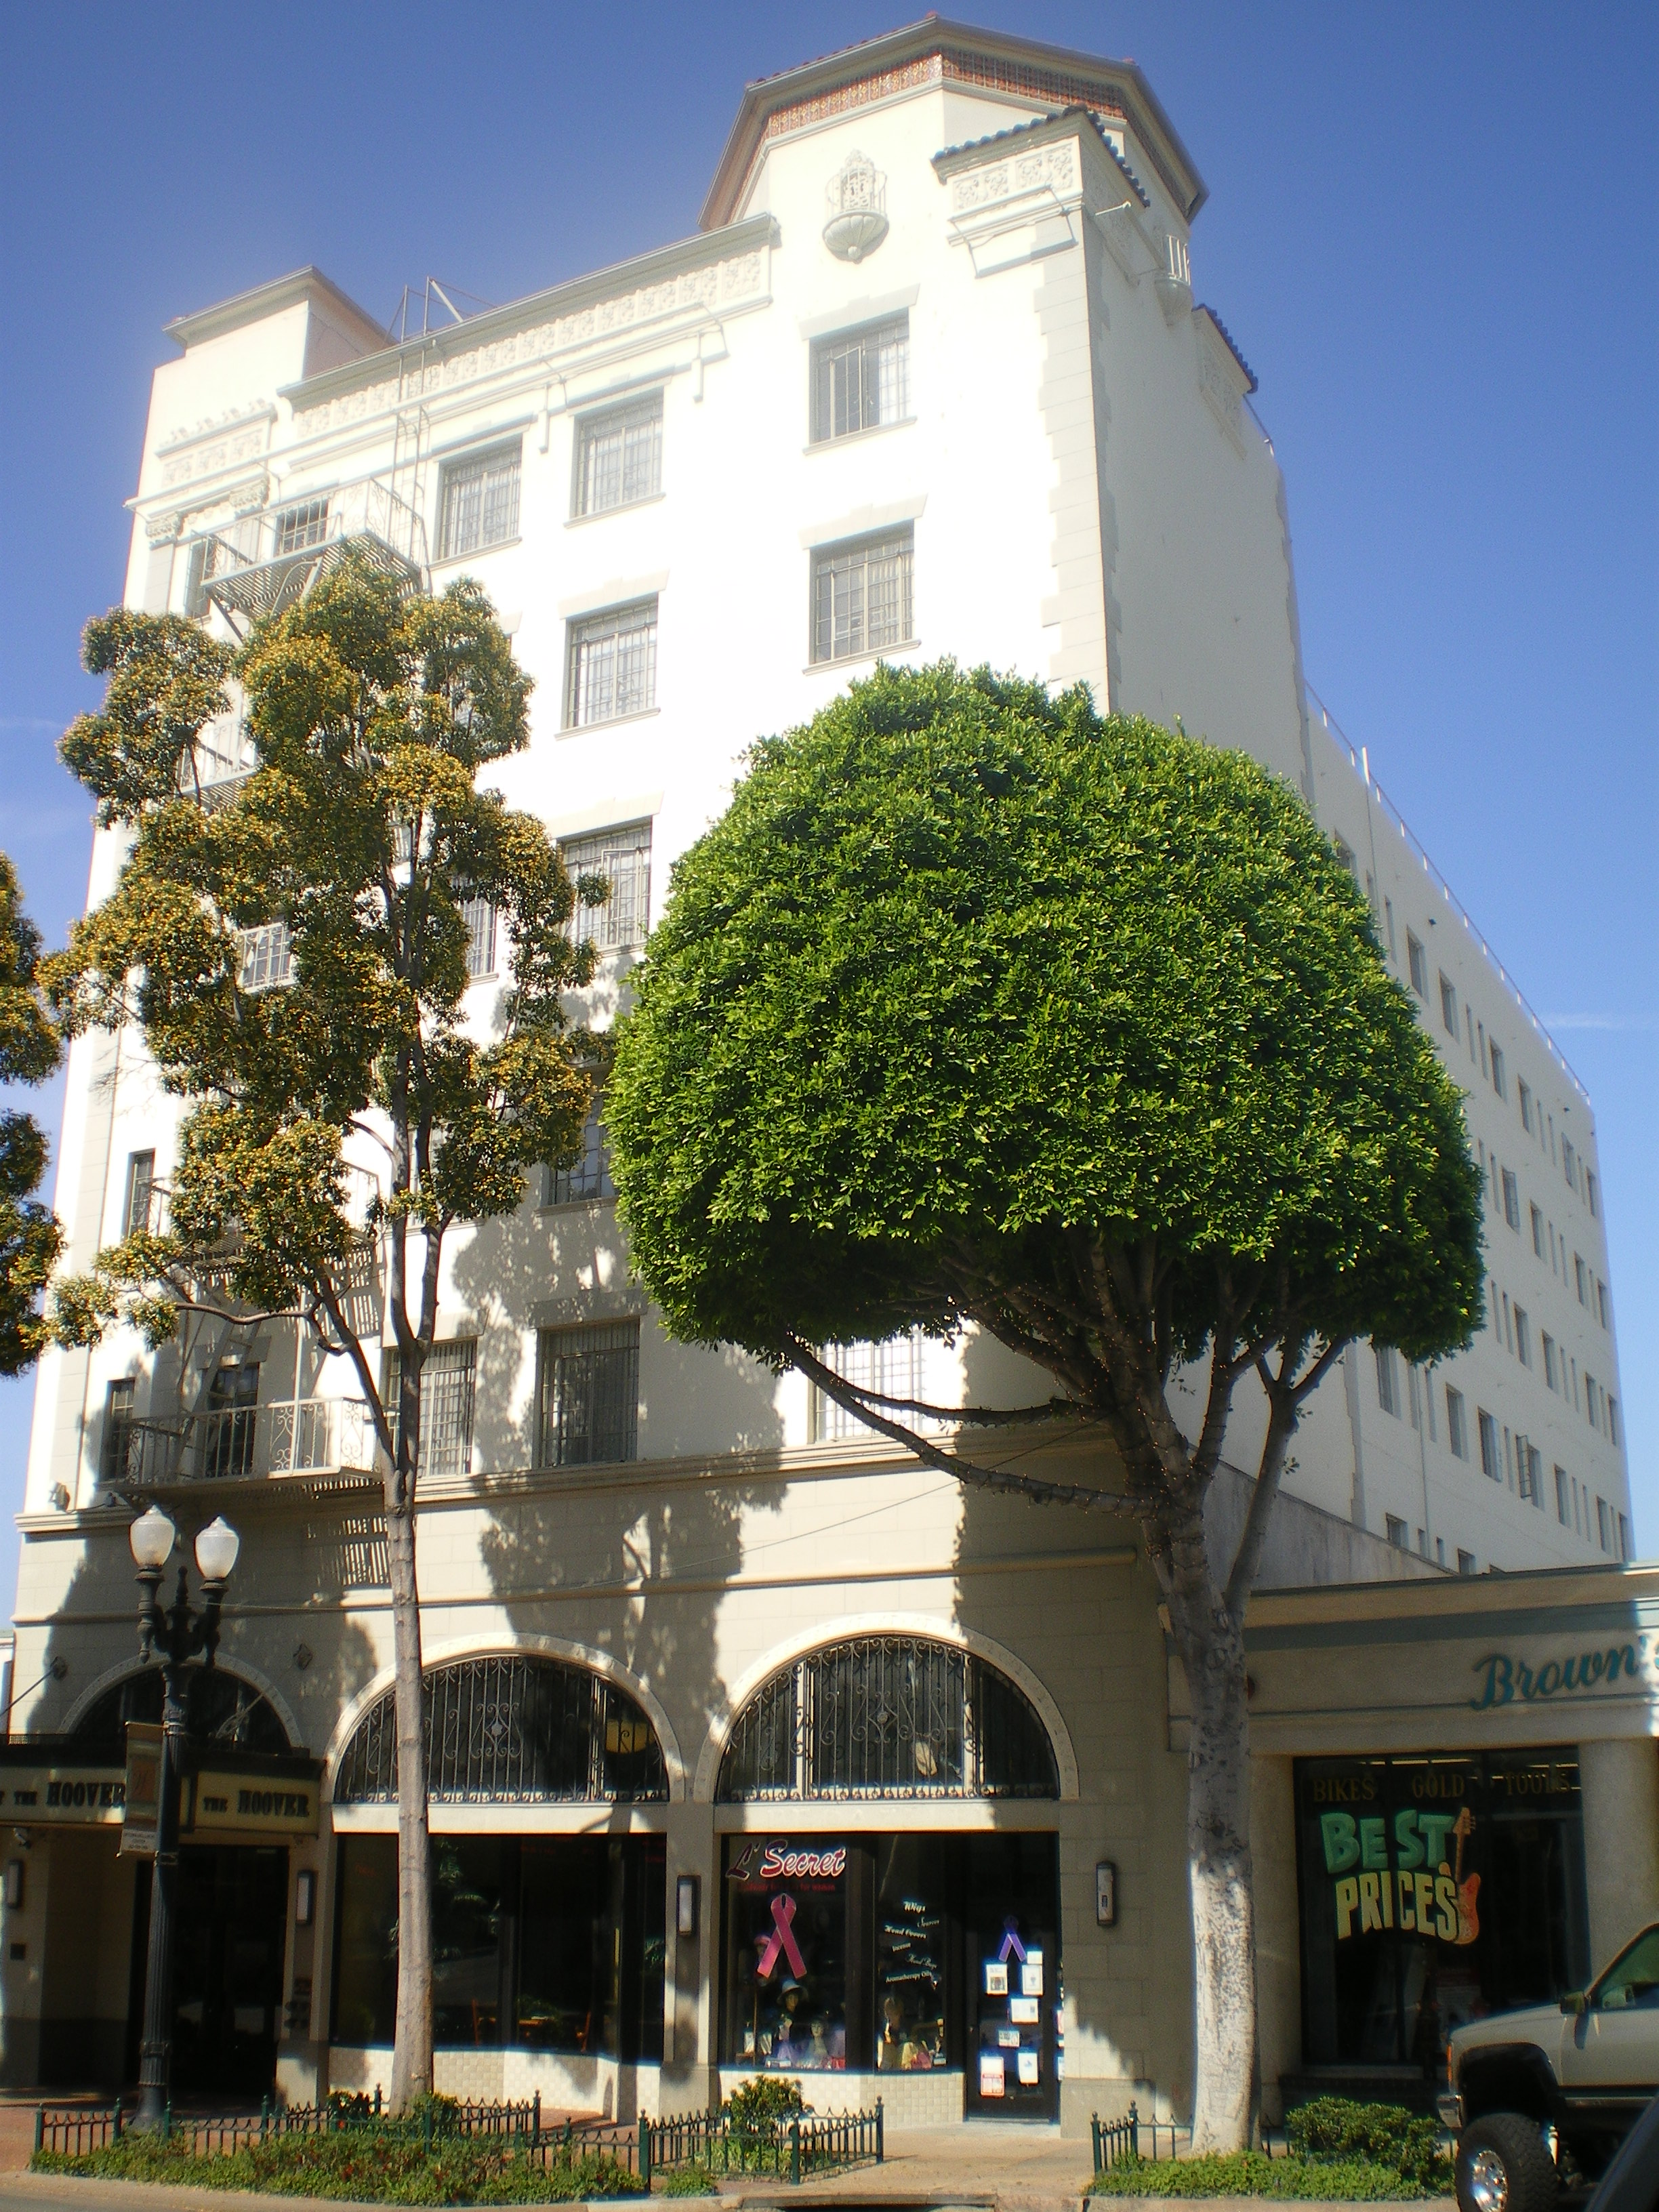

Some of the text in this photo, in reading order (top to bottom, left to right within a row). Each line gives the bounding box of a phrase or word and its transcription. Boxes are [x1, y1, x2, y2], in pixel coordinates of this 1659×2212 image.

[14, 1791, 37, 1805] THE
[47, 1782, 127, 1807] HOOVER
[1313, 1770, 1571, 1801] BIKES GOLD TOOLS
[205, 1789, 310, 1817] THE HOOVER
[1320, 1809, 1455, 1875] BEST
[760, 1839, 846, 1878] Secret
[903, 1901, 926, 1913] Wigs
[1335, 1870, 1459, 1942] PRICES
[886, 1973, 921, 1984] Aromatherapy
